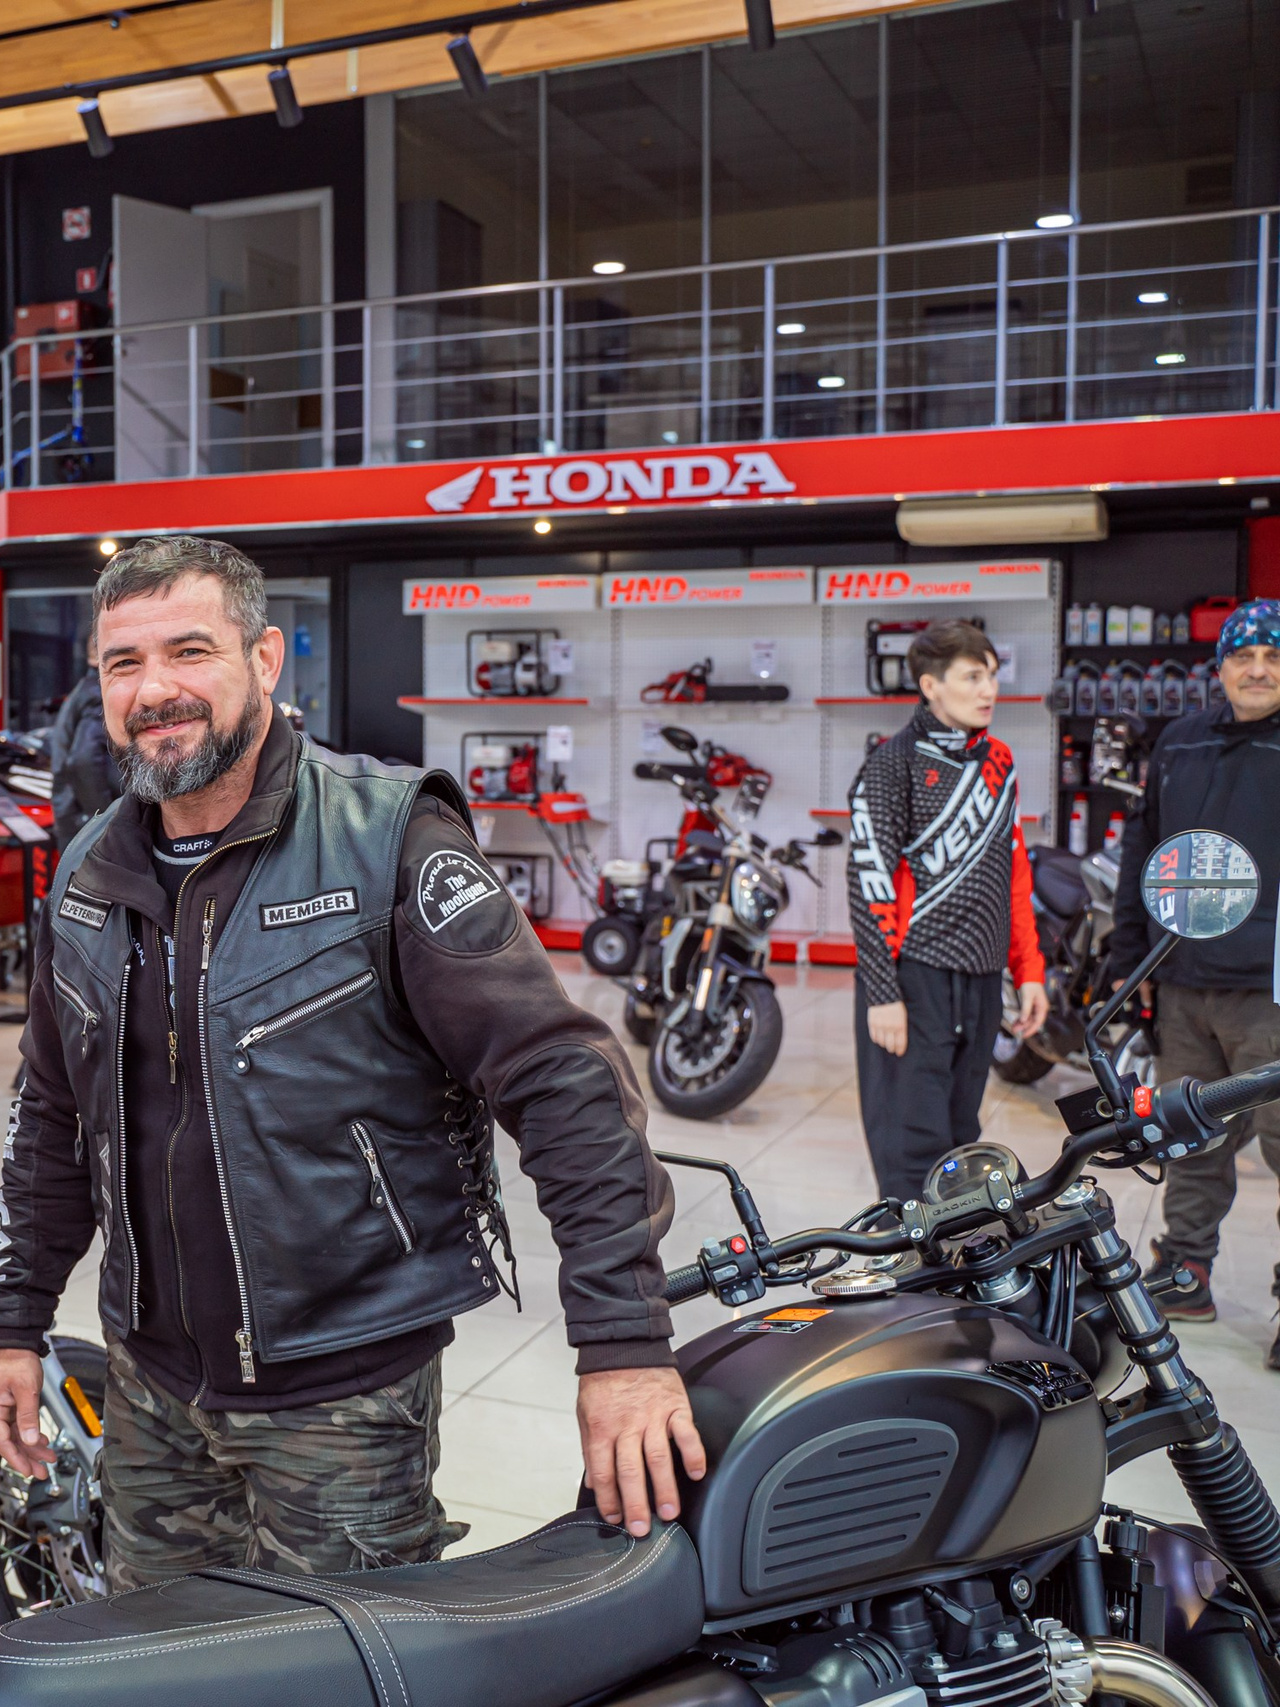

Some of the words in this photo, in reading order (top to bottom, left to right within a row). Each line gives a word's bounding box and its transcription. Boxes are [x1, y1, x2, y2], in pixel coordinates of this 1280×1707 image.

[488, 452, 796, 507] HONDA
[409, 584, 481, 609] HND
[482, 594, 532, 608] POWER
[609, 576, 688, 604] HND
[689, 587, 744, 600] POWER
[825, 571, 911, 599] HND
[912, 581, 972, 596] POWER
[173, 840, 205, 853] CRAFT
[421, 858, 446, 904] Proud
[446, 856, 462, 866] to
[443, 873, 467, 892] The
[268, 895, 349, 923] MEMBER
[438, 881, 488, 918] Hooligans
